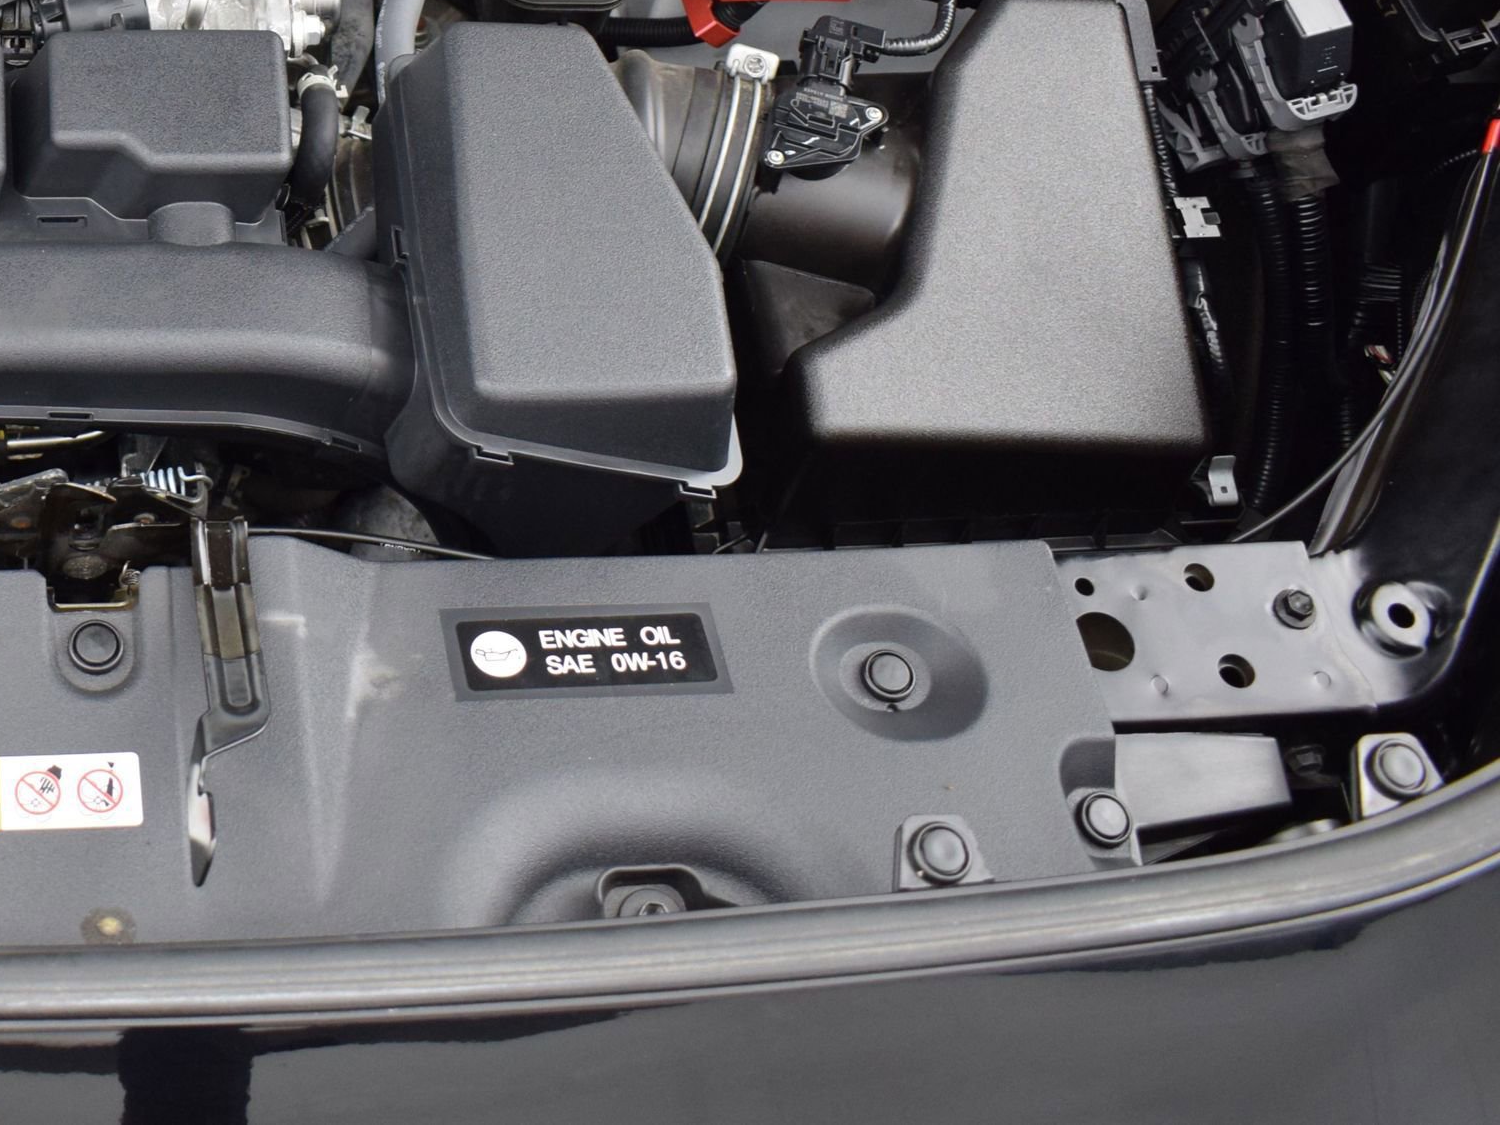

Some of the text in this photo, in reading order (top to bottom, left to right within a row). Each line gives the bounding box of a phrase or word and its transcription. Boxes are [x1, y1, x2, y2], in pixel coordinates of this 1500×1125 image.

[538, 625, 681, 650] ENGINE OIL
[546, 651, 687, 675] SAE 0W-16
